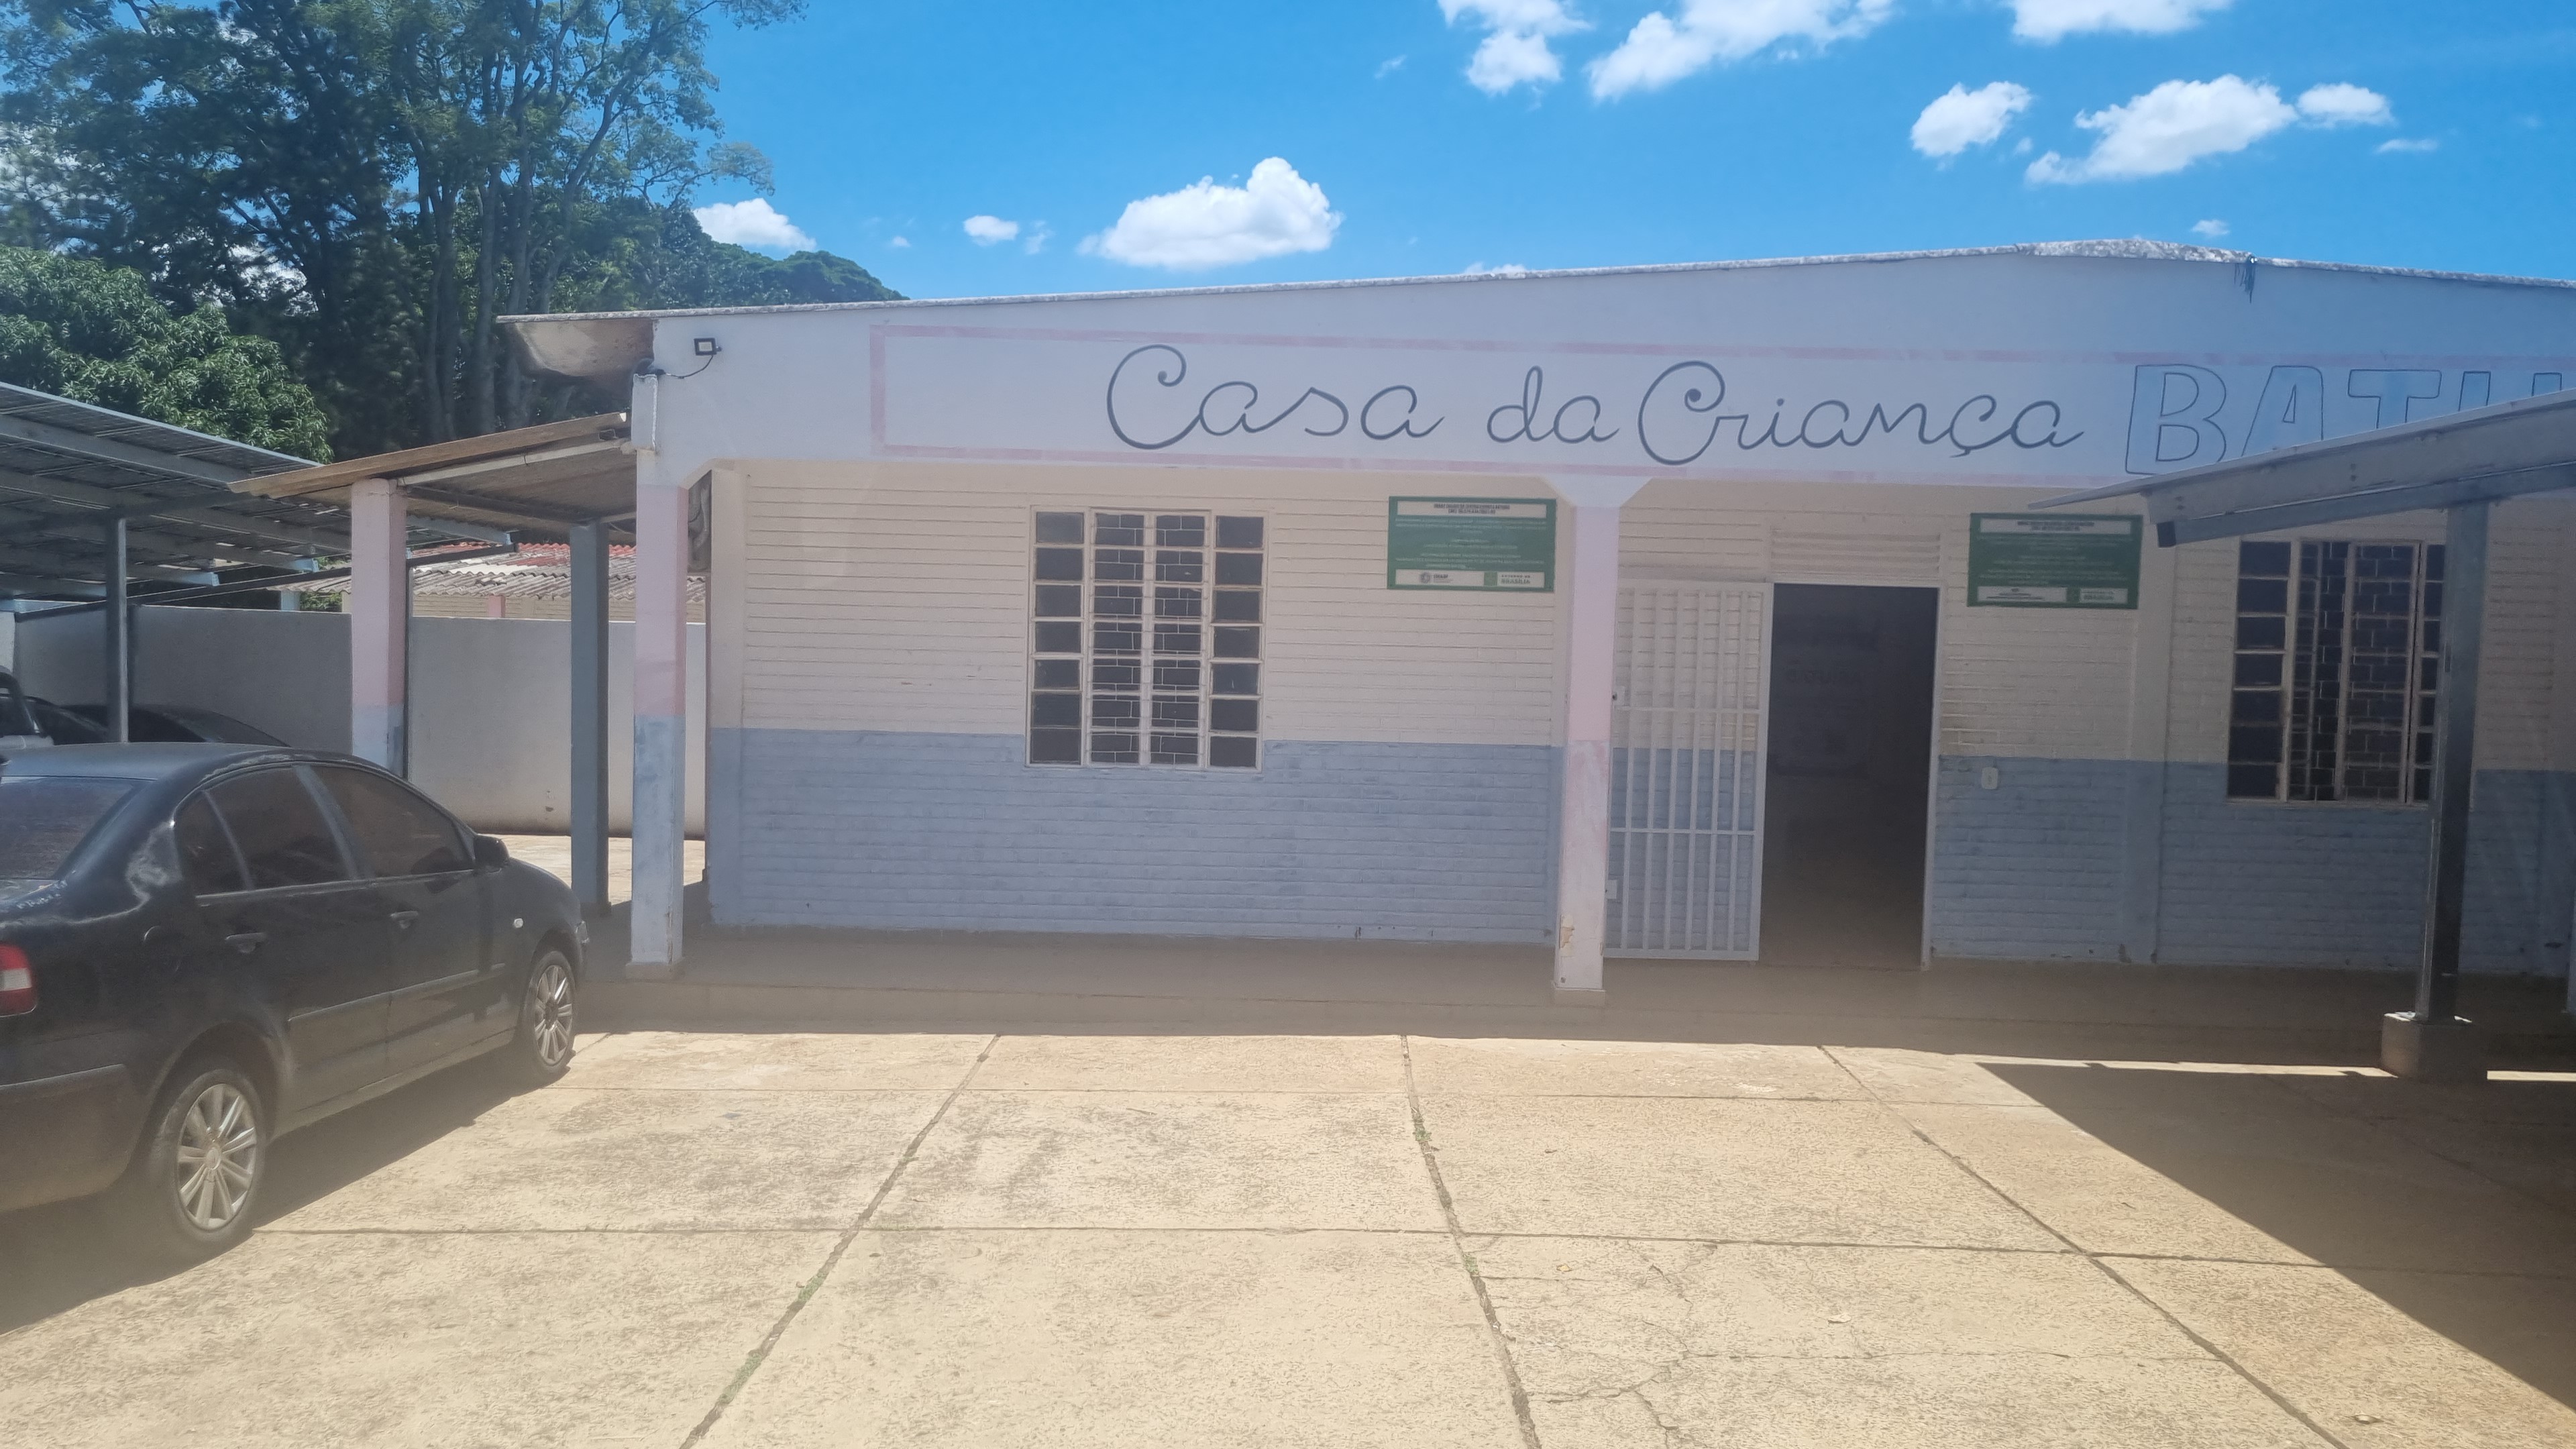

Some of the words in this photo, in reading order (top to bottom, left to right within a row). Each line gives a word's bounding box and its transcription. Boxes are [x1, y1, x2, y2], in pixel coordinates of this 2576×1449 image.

[1107, 343, 1445, 450] Casa
[1486, 365, 1620, 444] da
[1637, 360, 2086, 466] Criança
